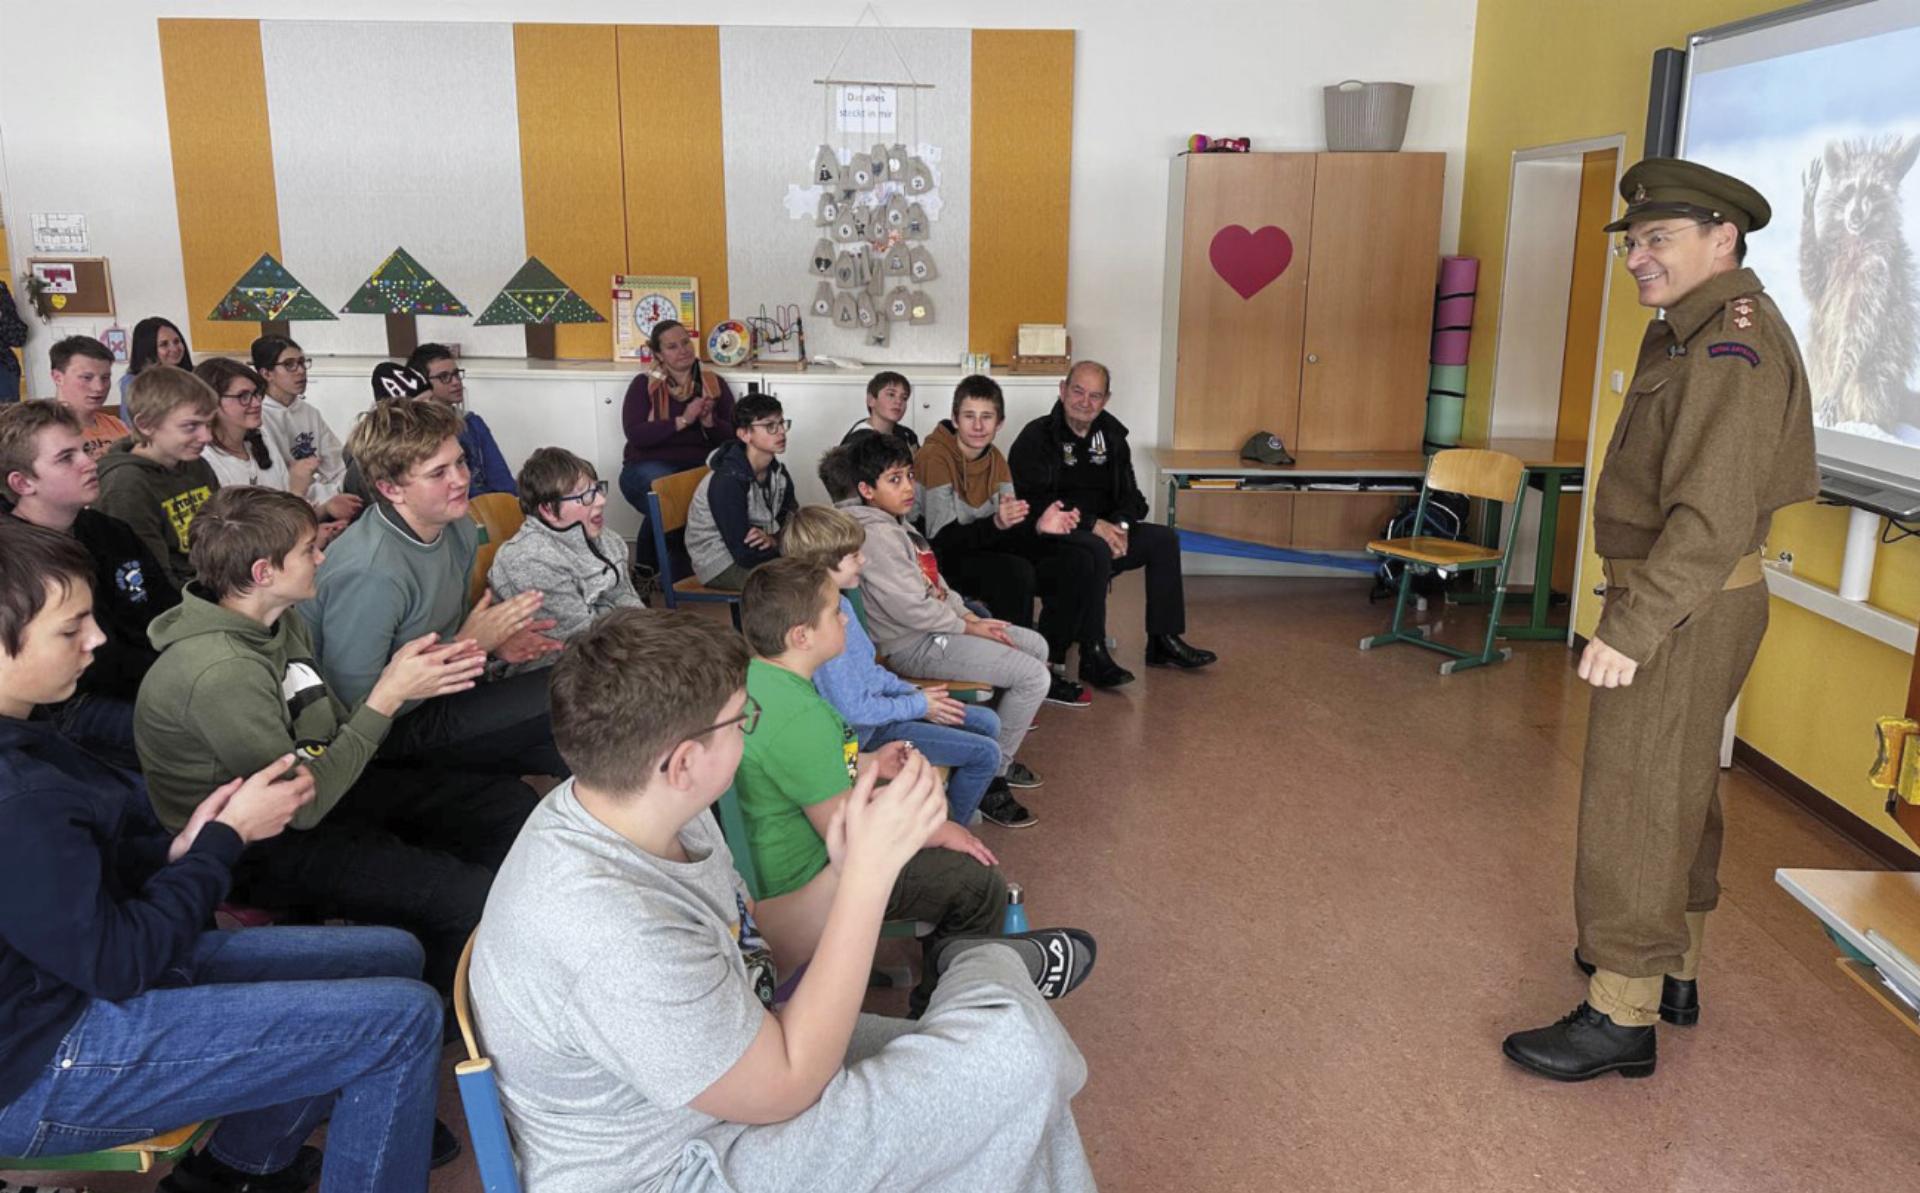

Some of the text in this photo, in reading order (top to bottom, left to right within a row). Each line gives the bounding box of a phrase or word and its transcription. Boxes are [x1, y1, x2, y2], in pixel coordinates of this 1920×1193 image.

[865, 93, 885, 103] alles
[867, 109, 876, 118] in
[879, 109, 893, 118] mir
[1040, 938, 1065, 997] FILA
